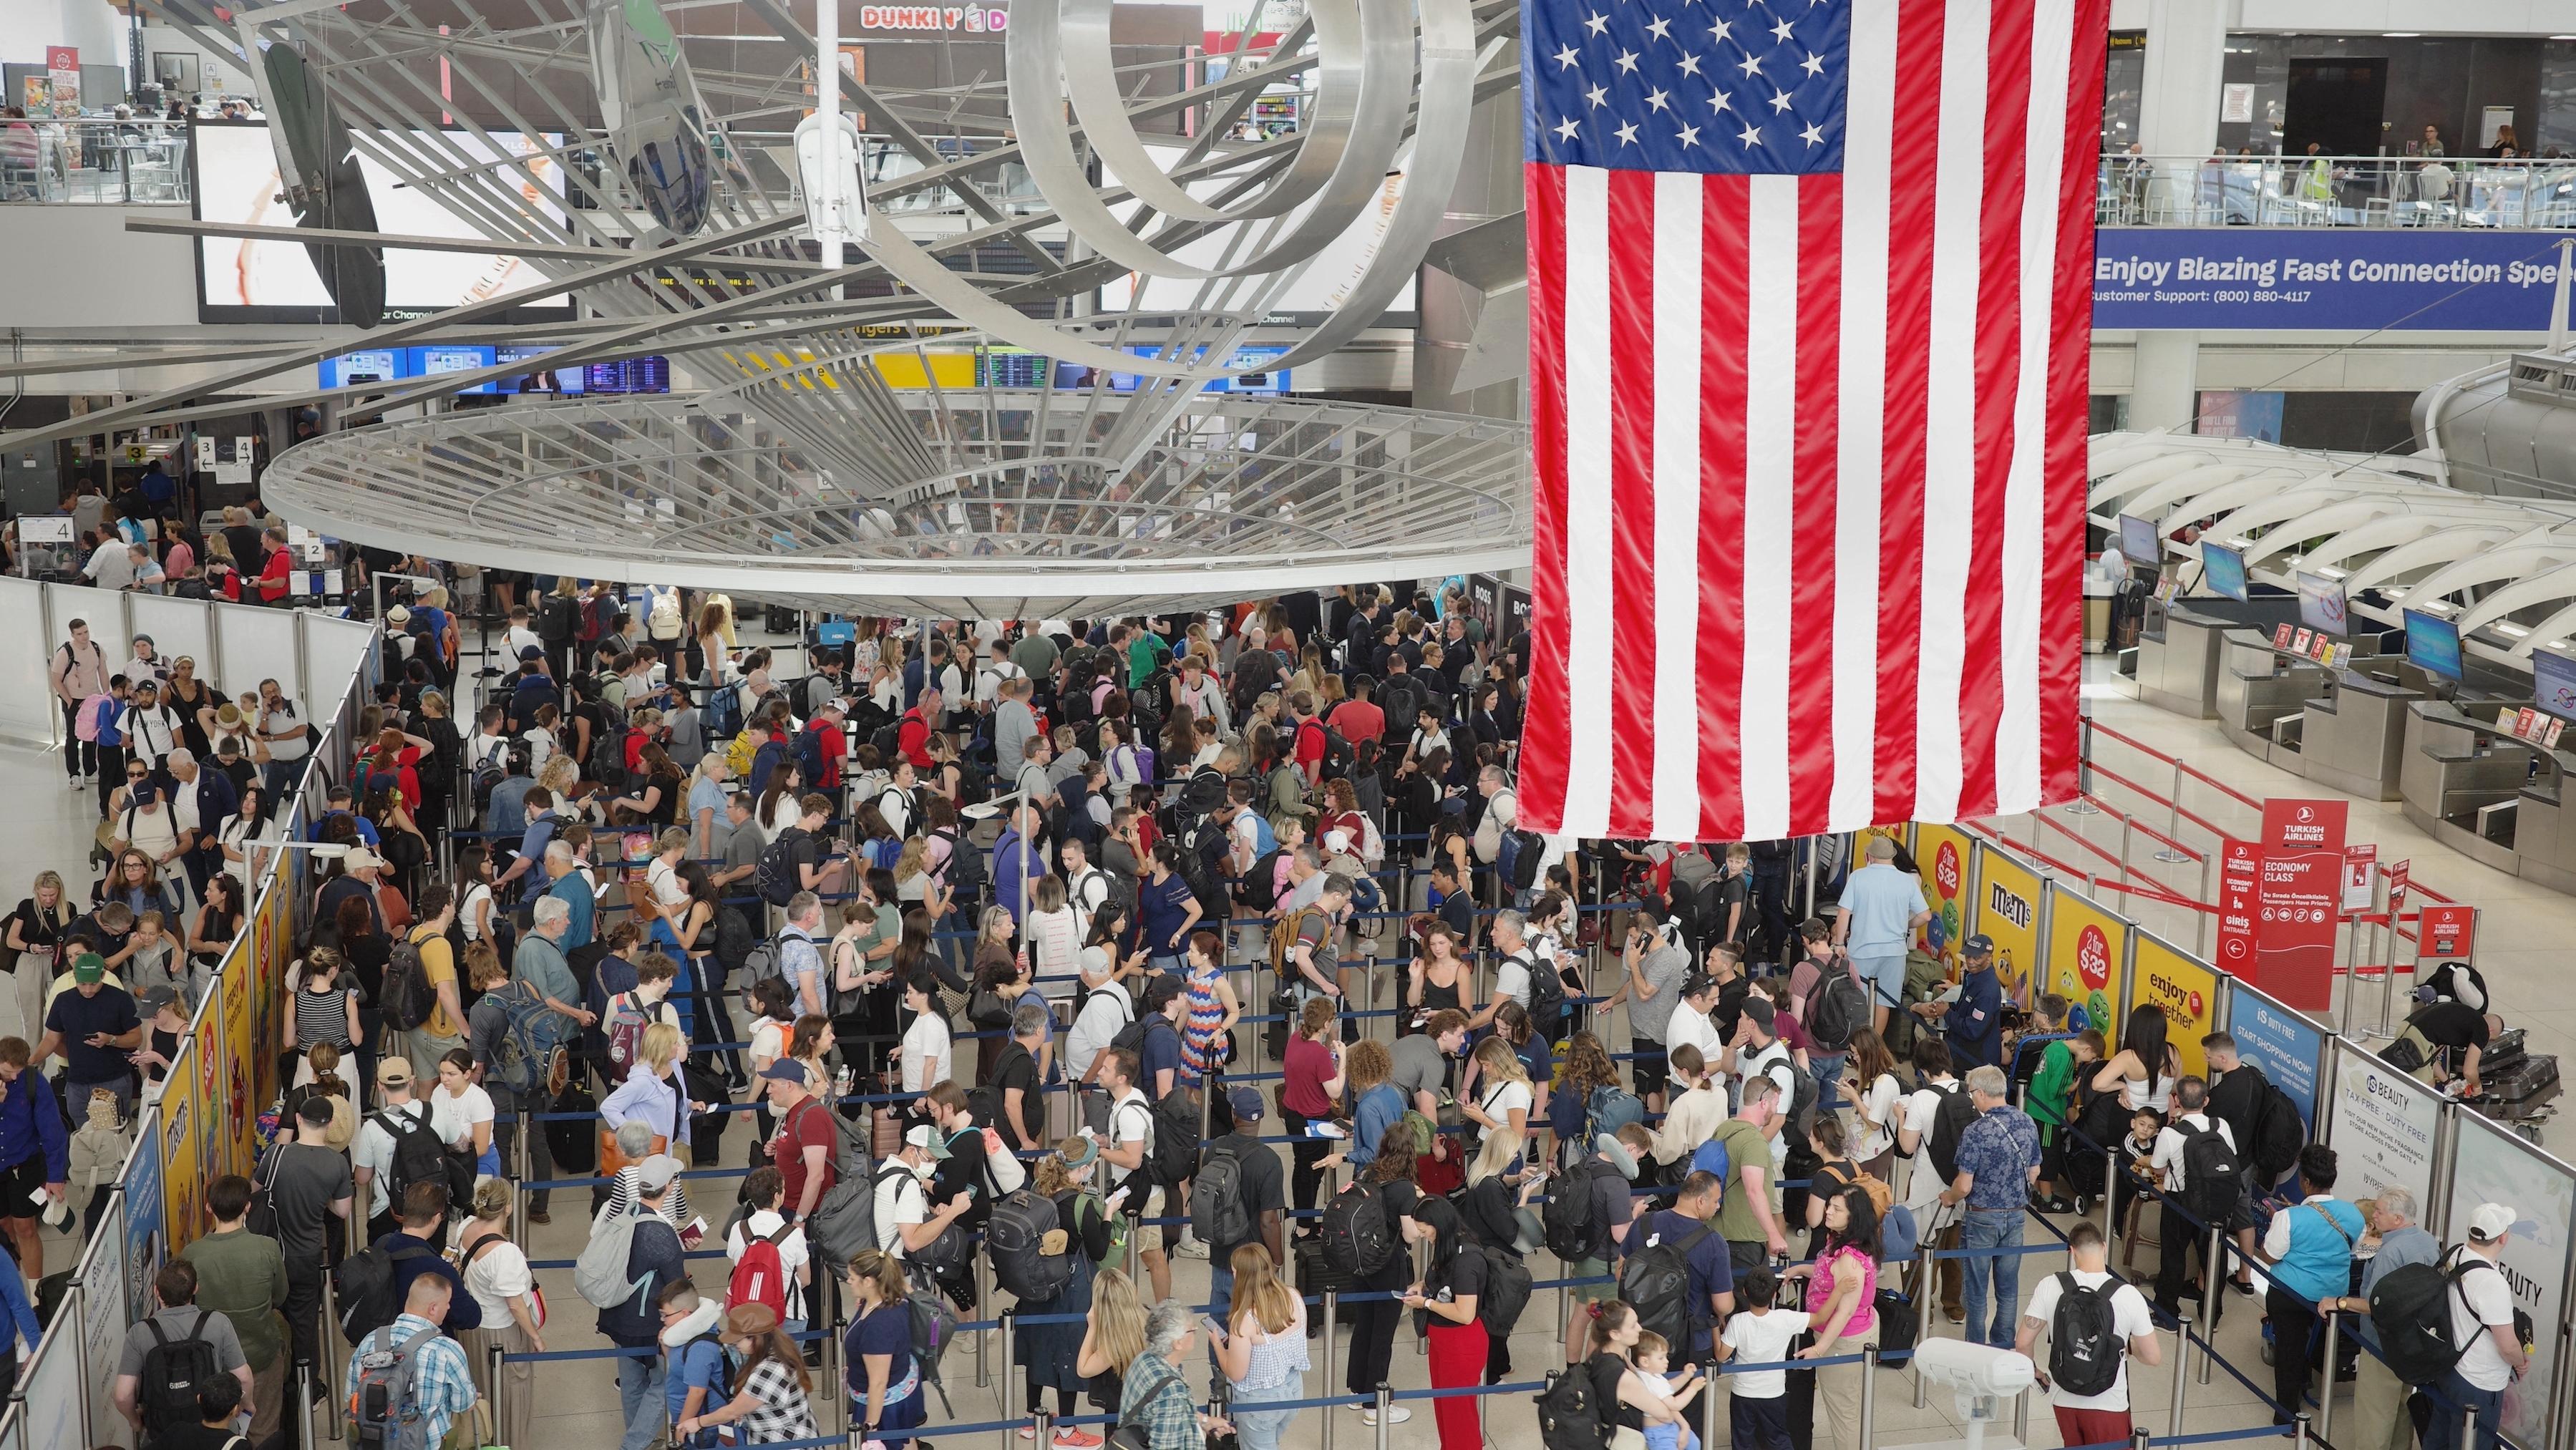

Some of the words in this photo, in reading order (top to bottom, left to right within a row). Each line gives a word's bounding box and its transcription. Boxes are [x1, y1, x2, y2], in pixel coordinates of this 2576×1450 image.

[863, 8, 961, 28] DUNKIN'
[2095, 256, 2172, 286] Enjoy
[2177, 256, 2277, 287] Blazing
[2283, 258, 2342, 281] Fast
[2348, 258, 2501, 283] Connection
[2154, 291, 2210, 303] Support:
[2214, 291, 2249, 303] (800)
[2253, 291, 2310, 302] 880-4117
[2223, 417, 2236, 425] FIND
[130, 447, 142, 459] 3
[203, 443, 210, 452] 3
[240, 442, 248, 452] 4
[57, 522, 69, 539] 4
[311, 545, 320, 555] 2
[1475, 585, 1491, 605] BOSS
[1513, 600, 1532, 616] BO
[2285, 825, 2324, 834] TURKISH
[1938, 861, 1957, 889] $32
[2227, 863, 2255, 872] AIRLINES
[2265, 862, 2311, 872] ECONOMY
[2227, 878, 2253, 887] ECONOMY
[2265, 872, 2293, 882] CLASS
[2226, 915, 2249, 928] GİRİŞ
[2223, 927, 2251, 935] ENTRANCE
[2086, 931, 2093, 950] 2
[2092, 934, 2104, 956] for
[2080, 948, 2106, 979] $32
[2150, 973, 2187, 1006] enjoy
[2268, 1017, 2281, 1032] DUTY
[2282, 1024, 2295, 1041] FREE
[2237, 1026, 2256, 1043] START
[2257, 1037, 2291, 1064] SHOPPING
[2292, 1057, 2312, 1076] NOW!
[2378, 1082, 2409, 1111] BEAUTY
[2346, 1089, 2359, 1103] TAX
[2362, 1098, 2379, 1116] FREE
[2386, 1112, 2406, 1132] DUTY
[2407, 1125, 2427, 1144] FREE
[2344, 1109, 2356, 1119] VISIT
[2356, 1114, 2366, 1125] OUR
[2367, 1121, 2378, 1134] NEW
[2379, 1128, 2393, 1142] NICHE
[2394, 1138, 2424, 1162] FRAGRANCE
[2349, 1120, 2364, 1134] STORE
[2365, 1130, 2383, 1146] ACROSS
[2384, 1142, 2398, 1154] FROM
[2398, 1151, 2412, 1164] GATE
[2362, 1154, 2377, 1166] ACQUA
[2381, 1166, 2398, 1178] PARMA
[2499, 1261, 2542, 1307] EAUTY
